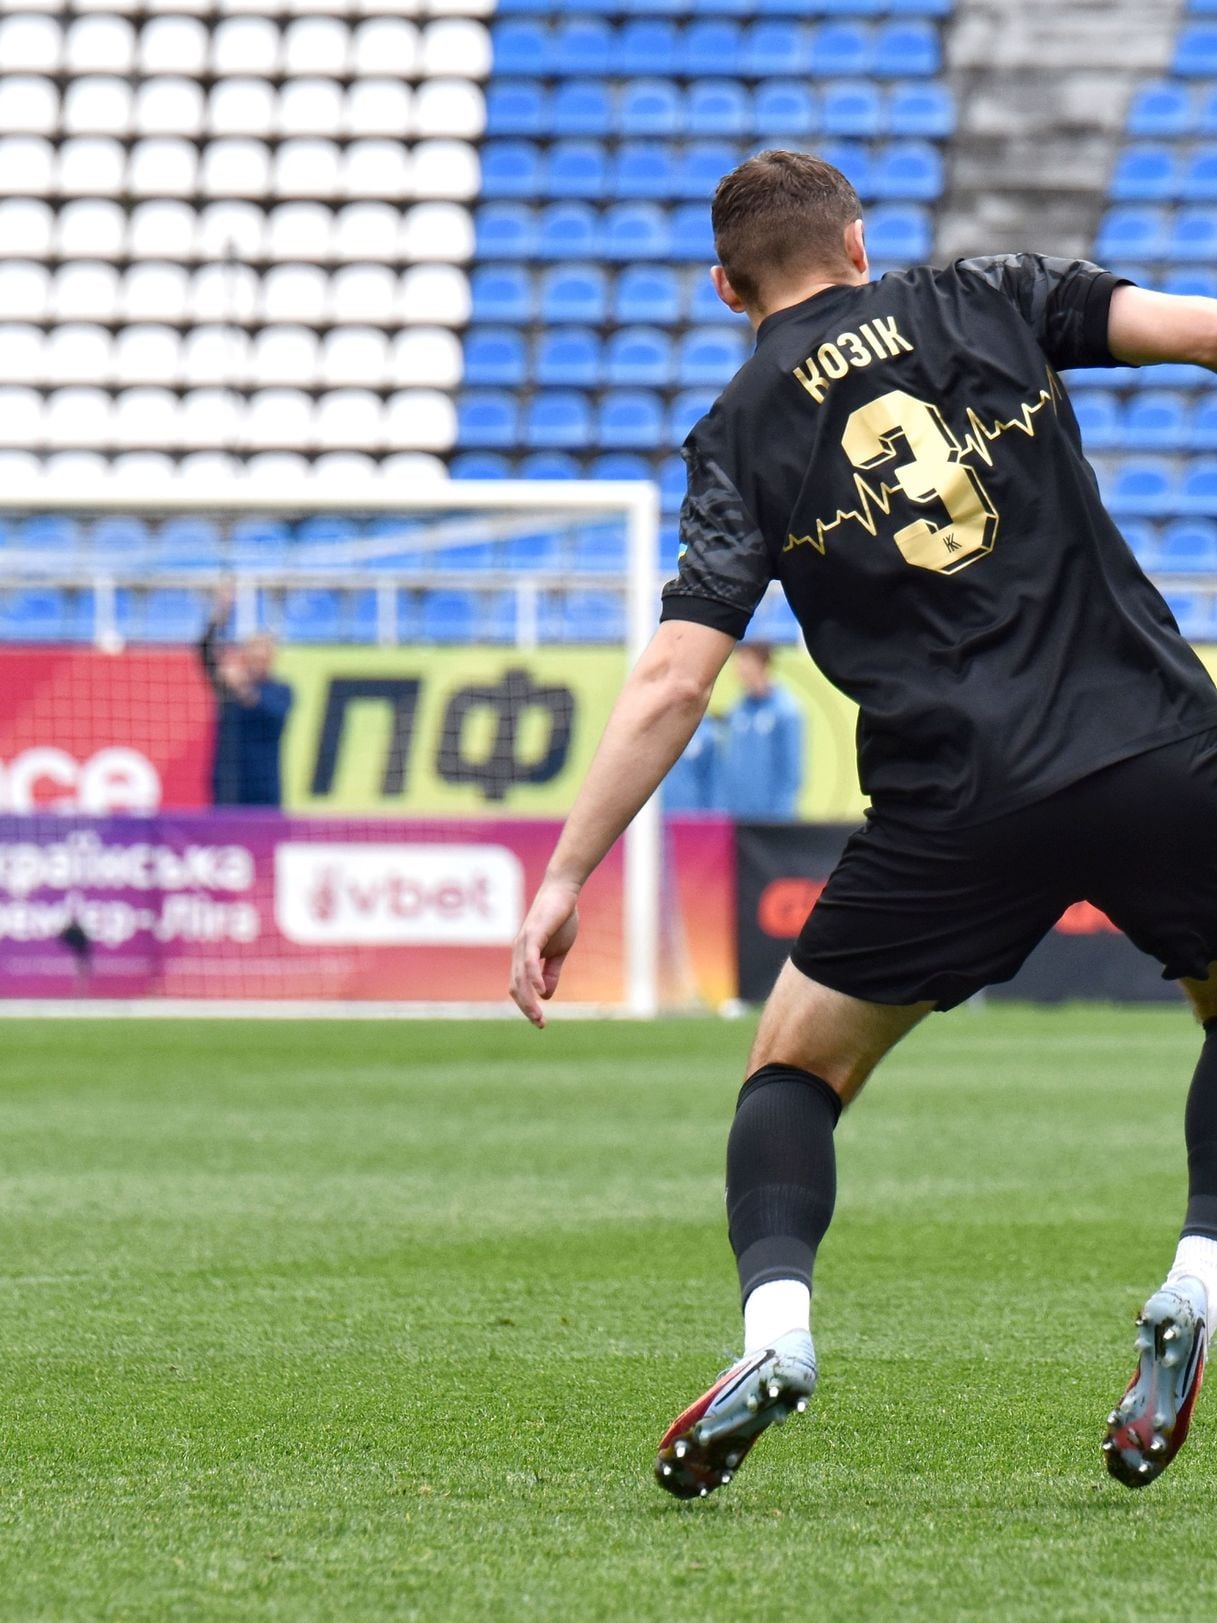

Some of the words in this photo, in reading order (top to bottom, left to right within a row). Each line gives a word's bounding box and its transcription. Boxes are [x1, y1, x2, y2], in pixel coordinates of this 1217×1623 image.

[792, 316, 914, 404] КОЗІК
[841, 390, 999, 575] 3
[0, 746, 162, 815] ce
